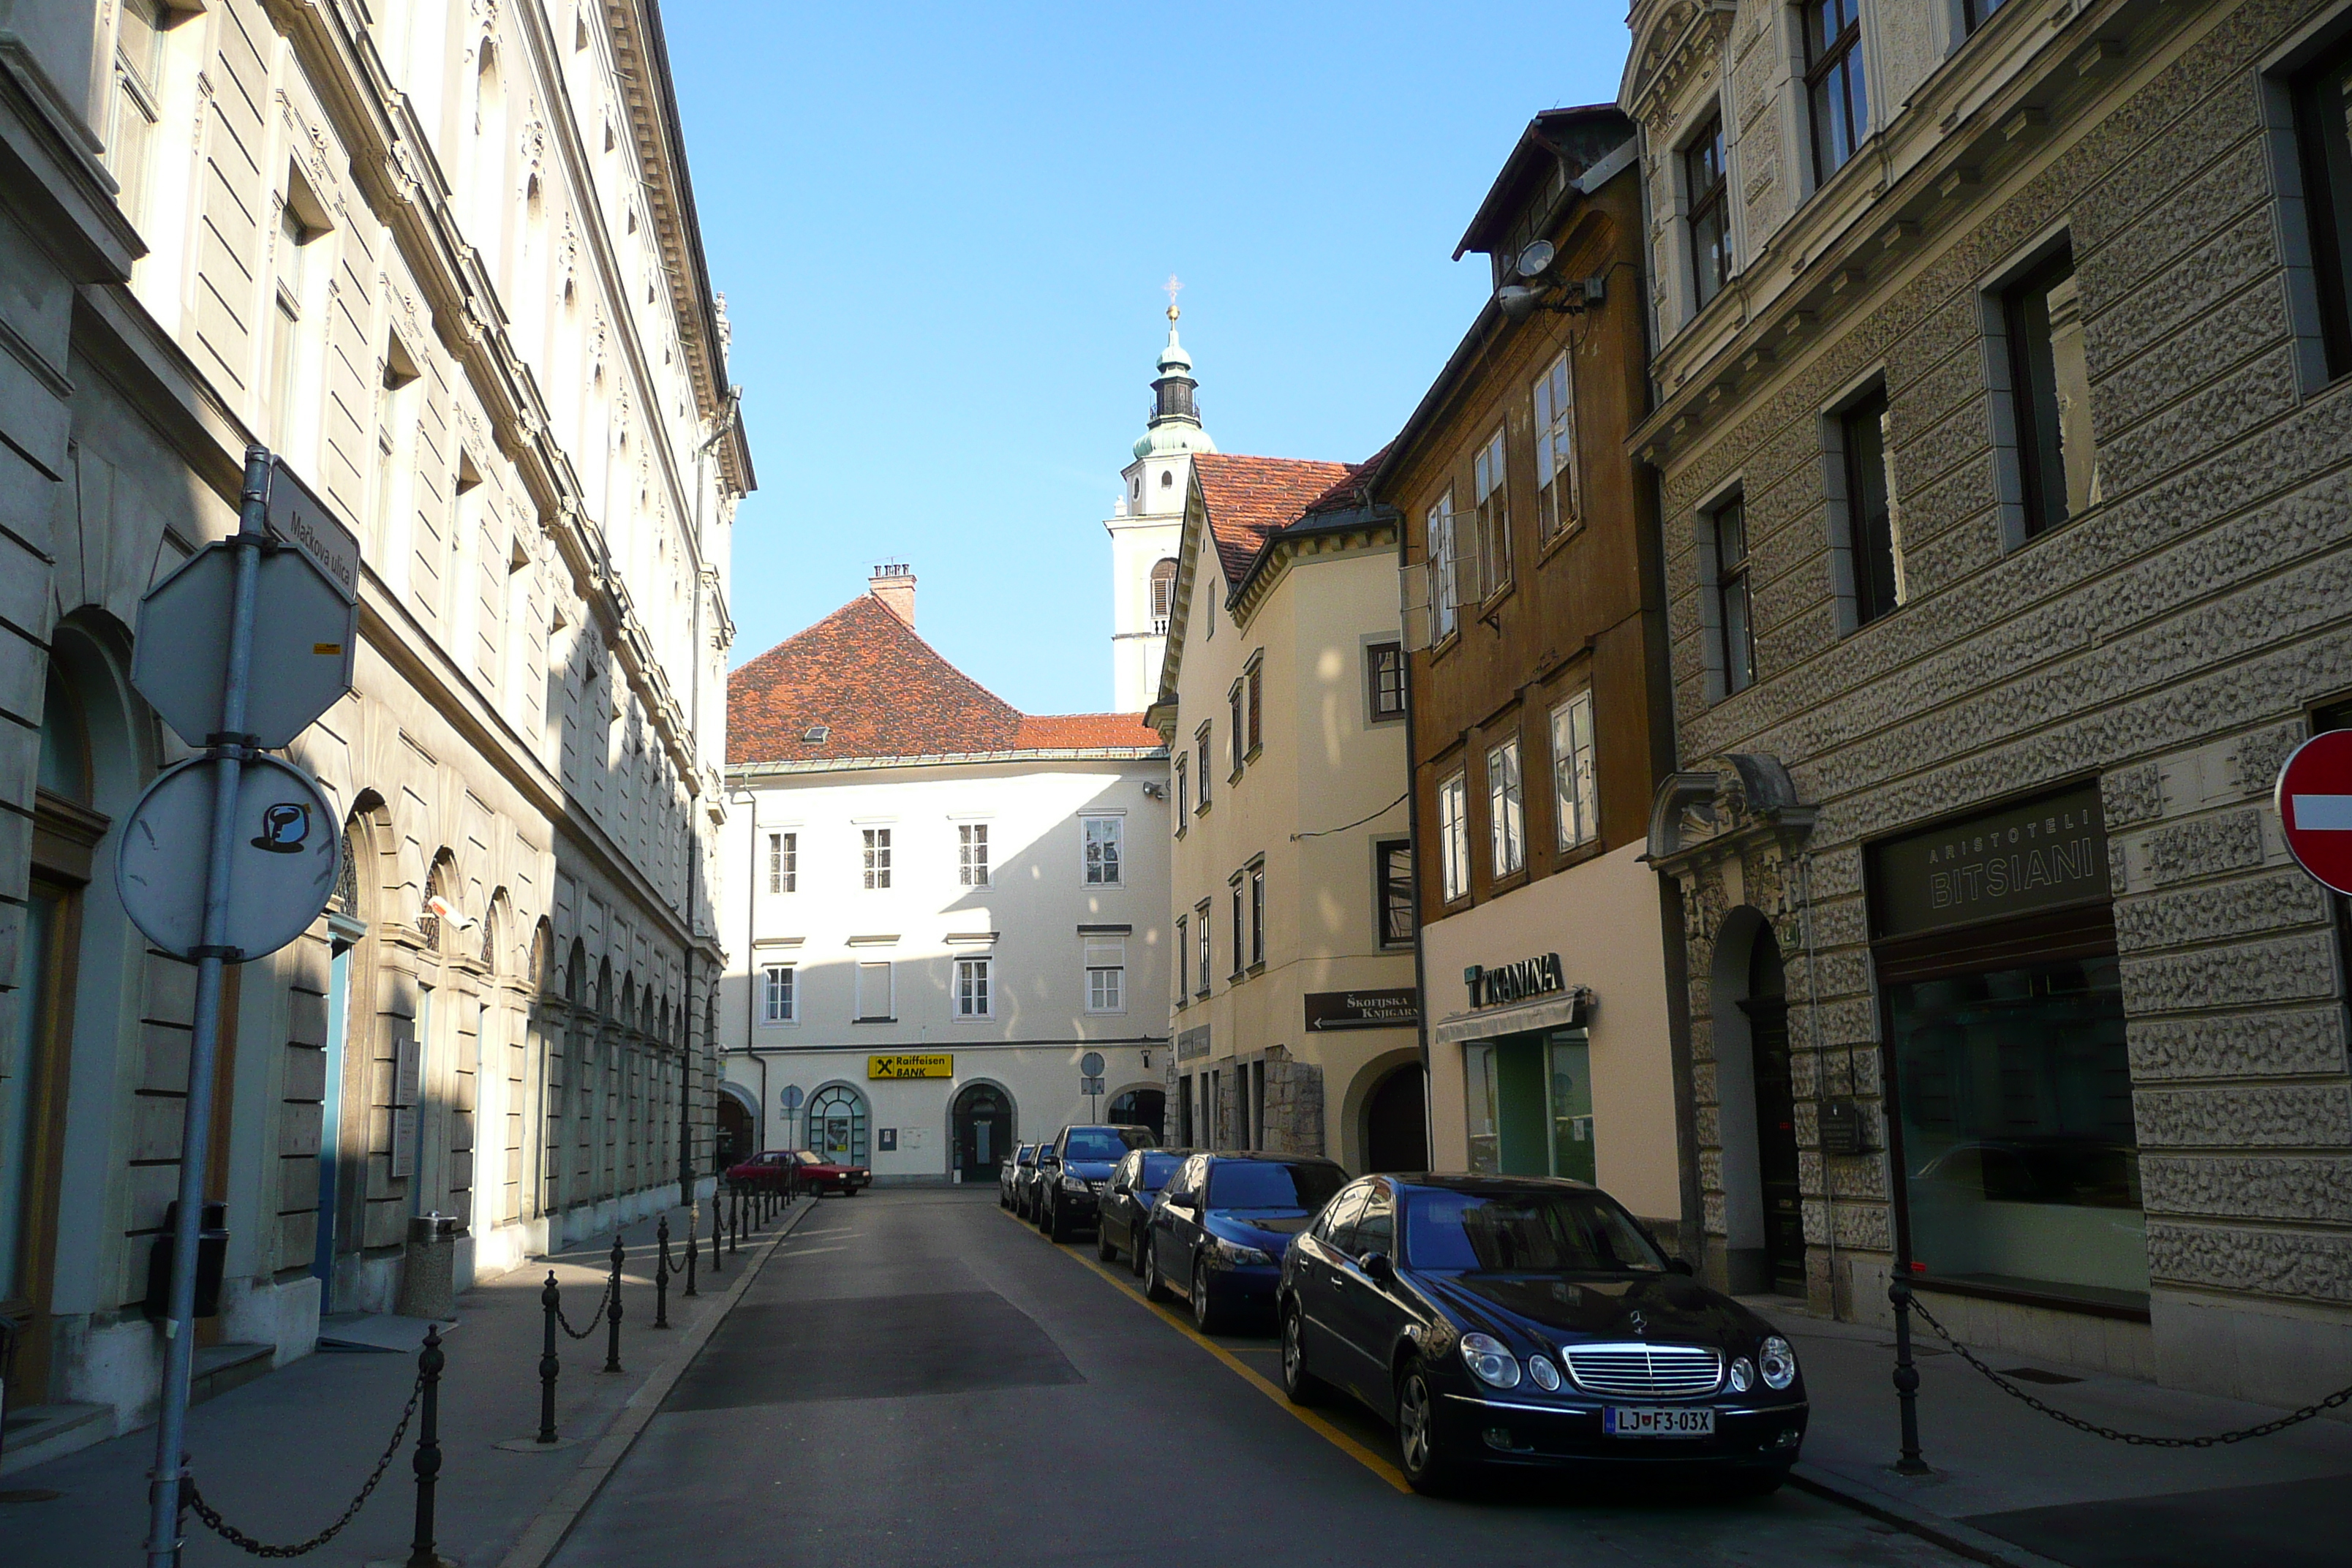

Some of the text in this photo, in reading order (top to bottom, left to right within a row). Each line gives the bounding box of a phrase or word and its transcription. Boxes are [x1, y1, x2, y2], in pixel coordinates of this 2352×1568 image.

[290, 510, 350, 586] Mačkova ulica
[1929, 809, 2088, 864] ARISTOTELI
[1930, 837, 2093, 909] BITSIANI
[1481, 952, 1564, 1006] TKANINA
[1347, 994, 1408, 1009] ŠKOFIJSKA
[897, 1055, 945, 1066] Raiffeisen
[897, 1068, 926, 1077] BANK
[1619, 1411, 1709, 1431] LJ F3-03X
